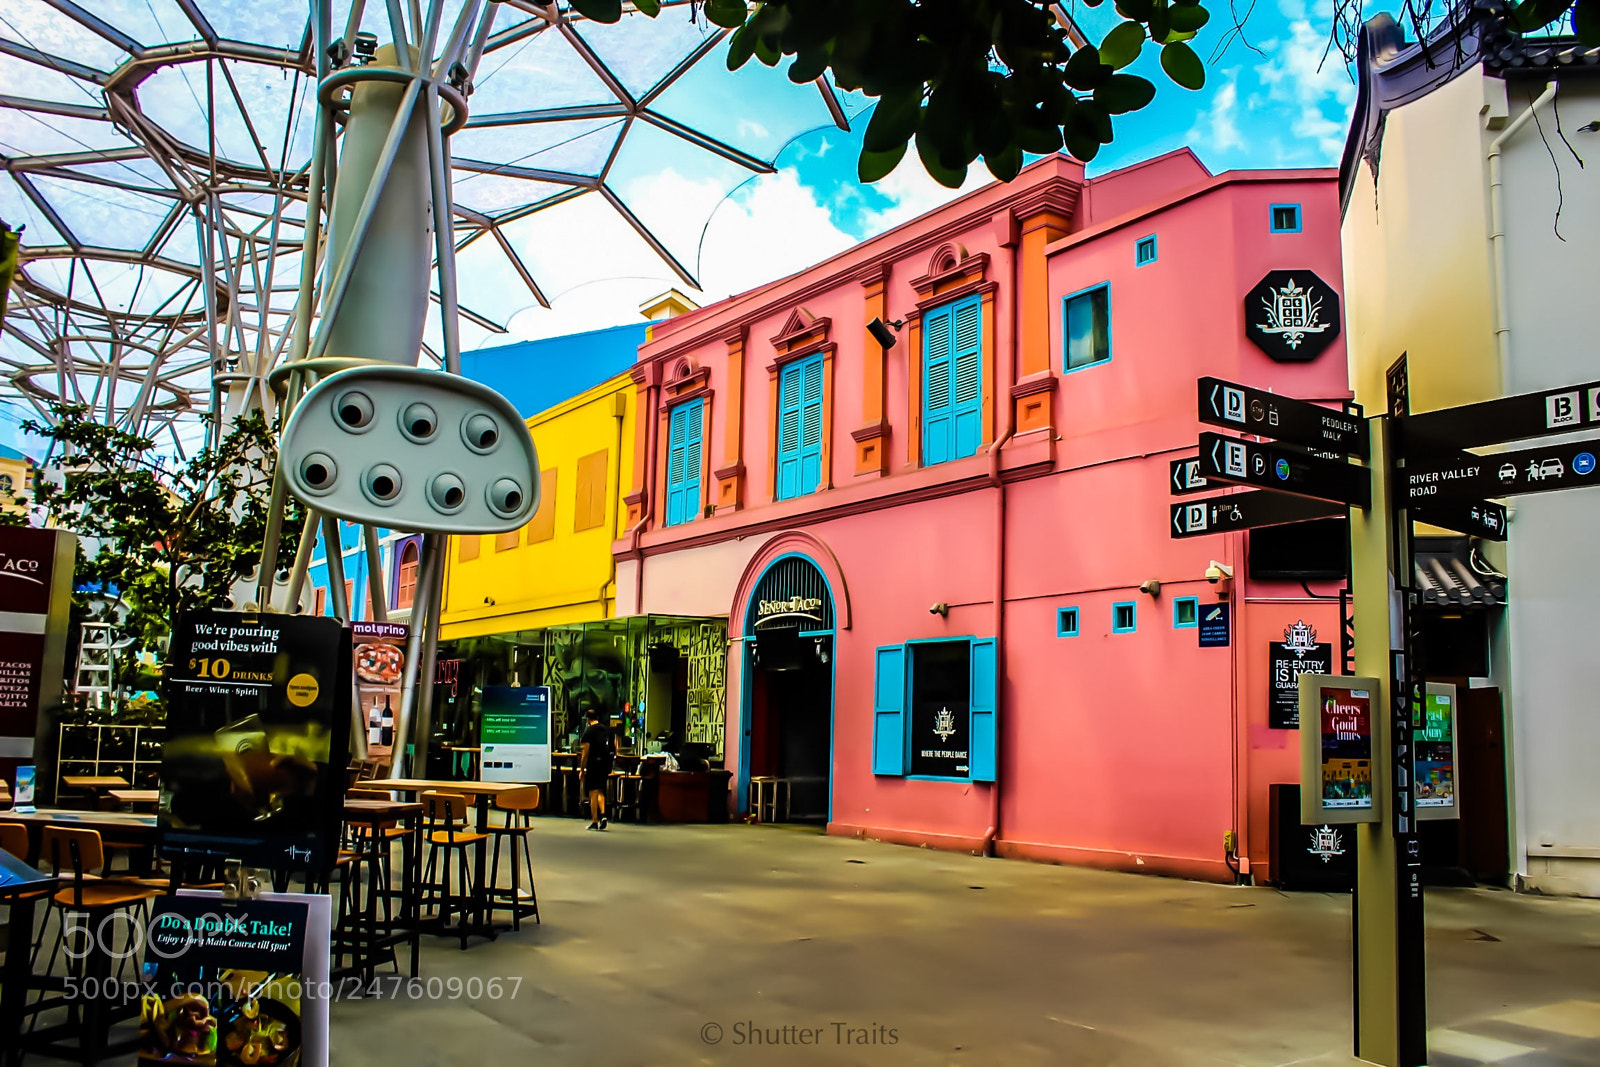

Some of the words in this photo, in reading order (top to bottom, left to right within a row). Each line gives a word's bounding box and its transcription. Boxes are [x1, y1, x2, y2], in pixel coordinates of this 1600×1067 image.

[1229, 391, 1240, 412] D
[1554, 397, 1572, 417] B
[1321, 416, 1358, 434] PEDDLER'S
[1553, 416, 1573, 424] BLOCK
[1322, 429, 1342, 441] WALK
[1231, 446, 1241, 467] E
[1229, 465, 1243, 473] BLOCK
[1409, 472, 1439, 485] RIVER
[1441, 466, 1480, 481] VALLEY
[1409, 485, 1437, 498] ROAD
[1191, 507, 1202, 524] D
[0, 553, 39, 572] ACO
[195, 623, 228, 635] We're
[229, 626, 280, 640] pouring
[191, 640, 218, 653] good
[220, 641, 250, 653] vibes
[250, 642, 278, 654] with
[188, 657, 231, 679] $10
[232, 671, 274, 681] DRINKS
[1275, 659, 1325, 669] RE-ENTRY
[1275, 668, 1289, 682] IS
[185, 685, 203, 694] Beer
[209, 686, 230, 695] Wine
[235, 687, 258, 696] Spirit
[1325, 699, 1360, 715] Cheers
[1331, 716, 1357, 731] Good
[160, 914, 181, 930] Do
[194, 917, 247, 933] Double
[250, 920, 293, 937] Take!
[157, 933, 180, 945] Enjoy
[205, 936, 227, 947] Main
[228, 938, 257, 949] Course
[257, 940, 270, 950] till
